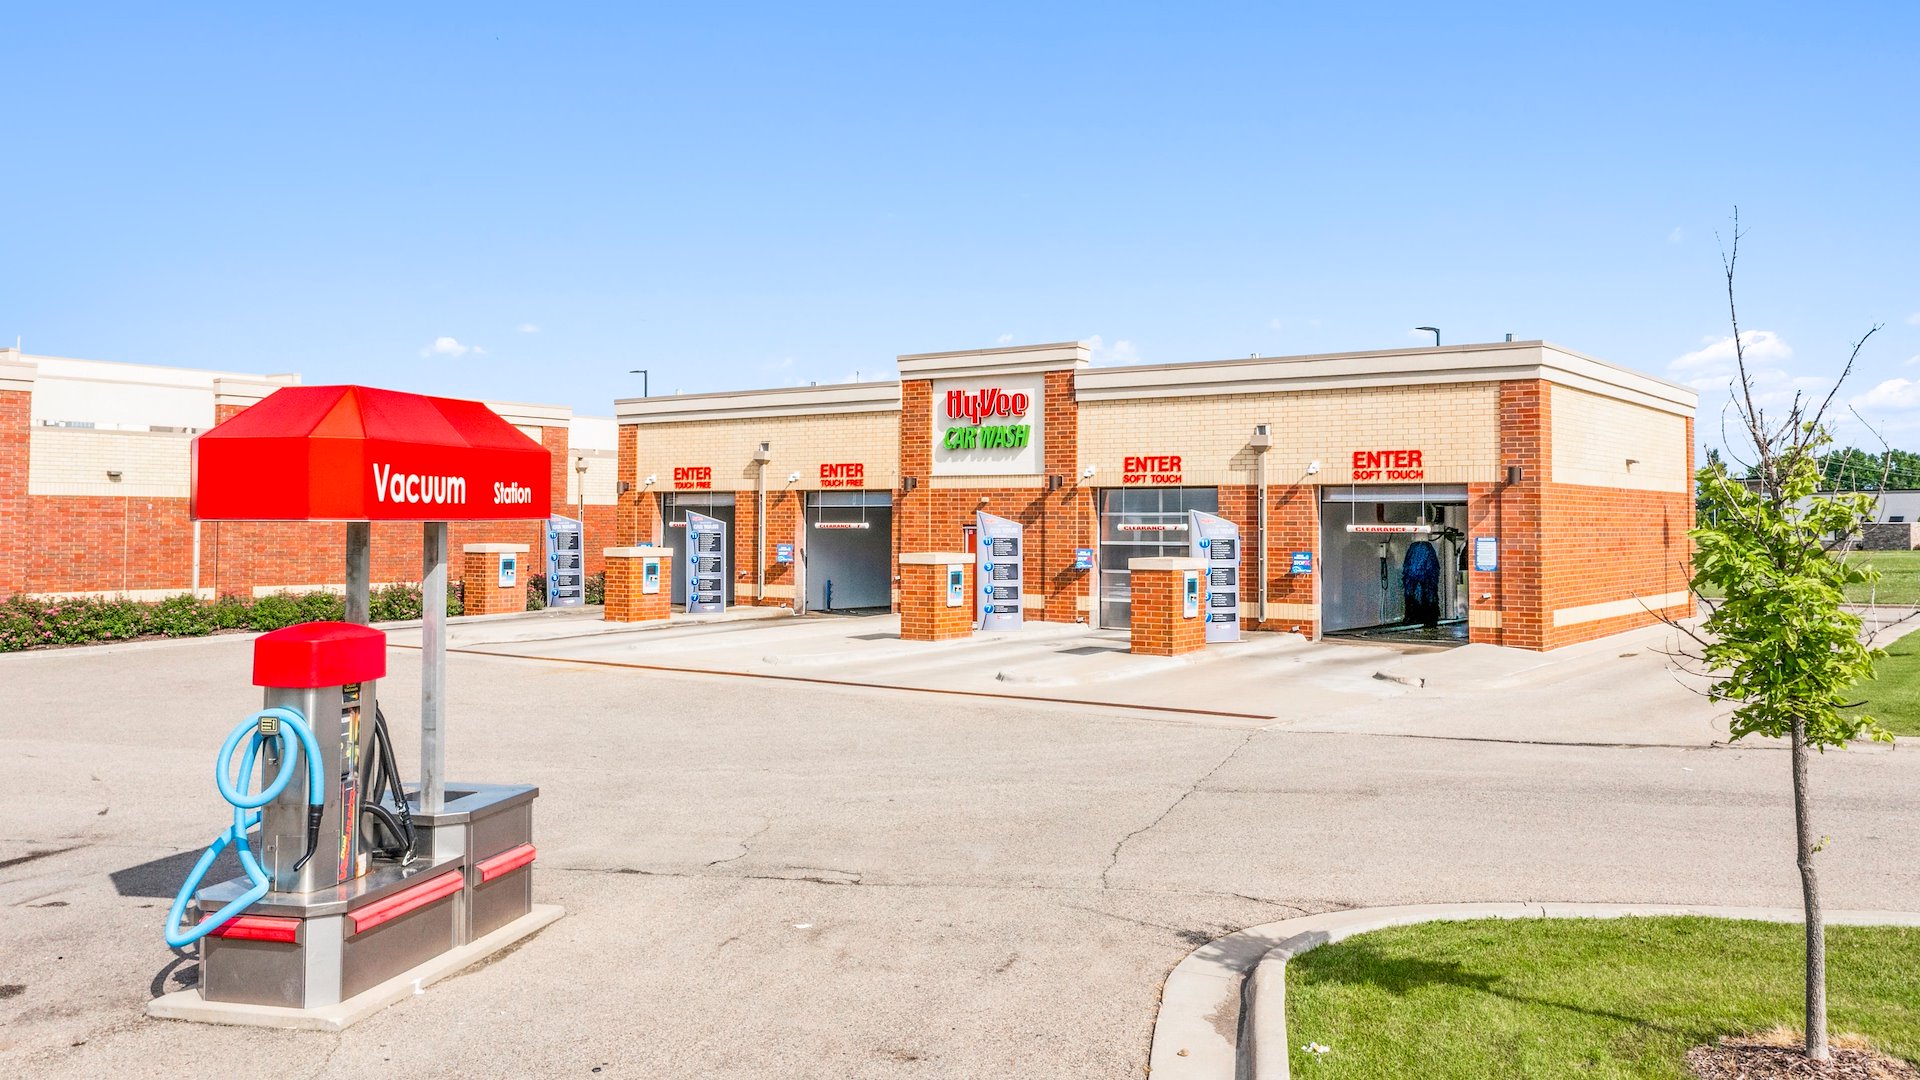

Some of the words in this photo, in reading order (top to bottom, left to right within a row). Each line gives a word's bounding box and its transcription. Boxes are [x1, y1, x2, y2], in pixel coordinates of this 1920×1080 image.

[943, 426, 977, 449] CAR
[978, 425, 1031, 449] WASH
[1124, 456, 1182, 473] ENTER
[1353, 450, 1423, 469] ENTER
[674, 467, 712, 480] ENTER
[820, 464, 864, 478] ENTER
[1353, 471, 1381, 480] SOFT
[1386, 470, 1424, 480] TOUCH
[372, 463, 466, 504] Vacuum
[493, 481, 532, 504] Station
[675, 481, 695, 489] TOUCH
[696, 481, 711, 489] FREE
[821, 479, 844, 488] TOUCH
[846, 479, 864, 487] FREE
[1123, 474, 1148, 484] SOFT
[1151, 474, 1182, 484] TOUCH
